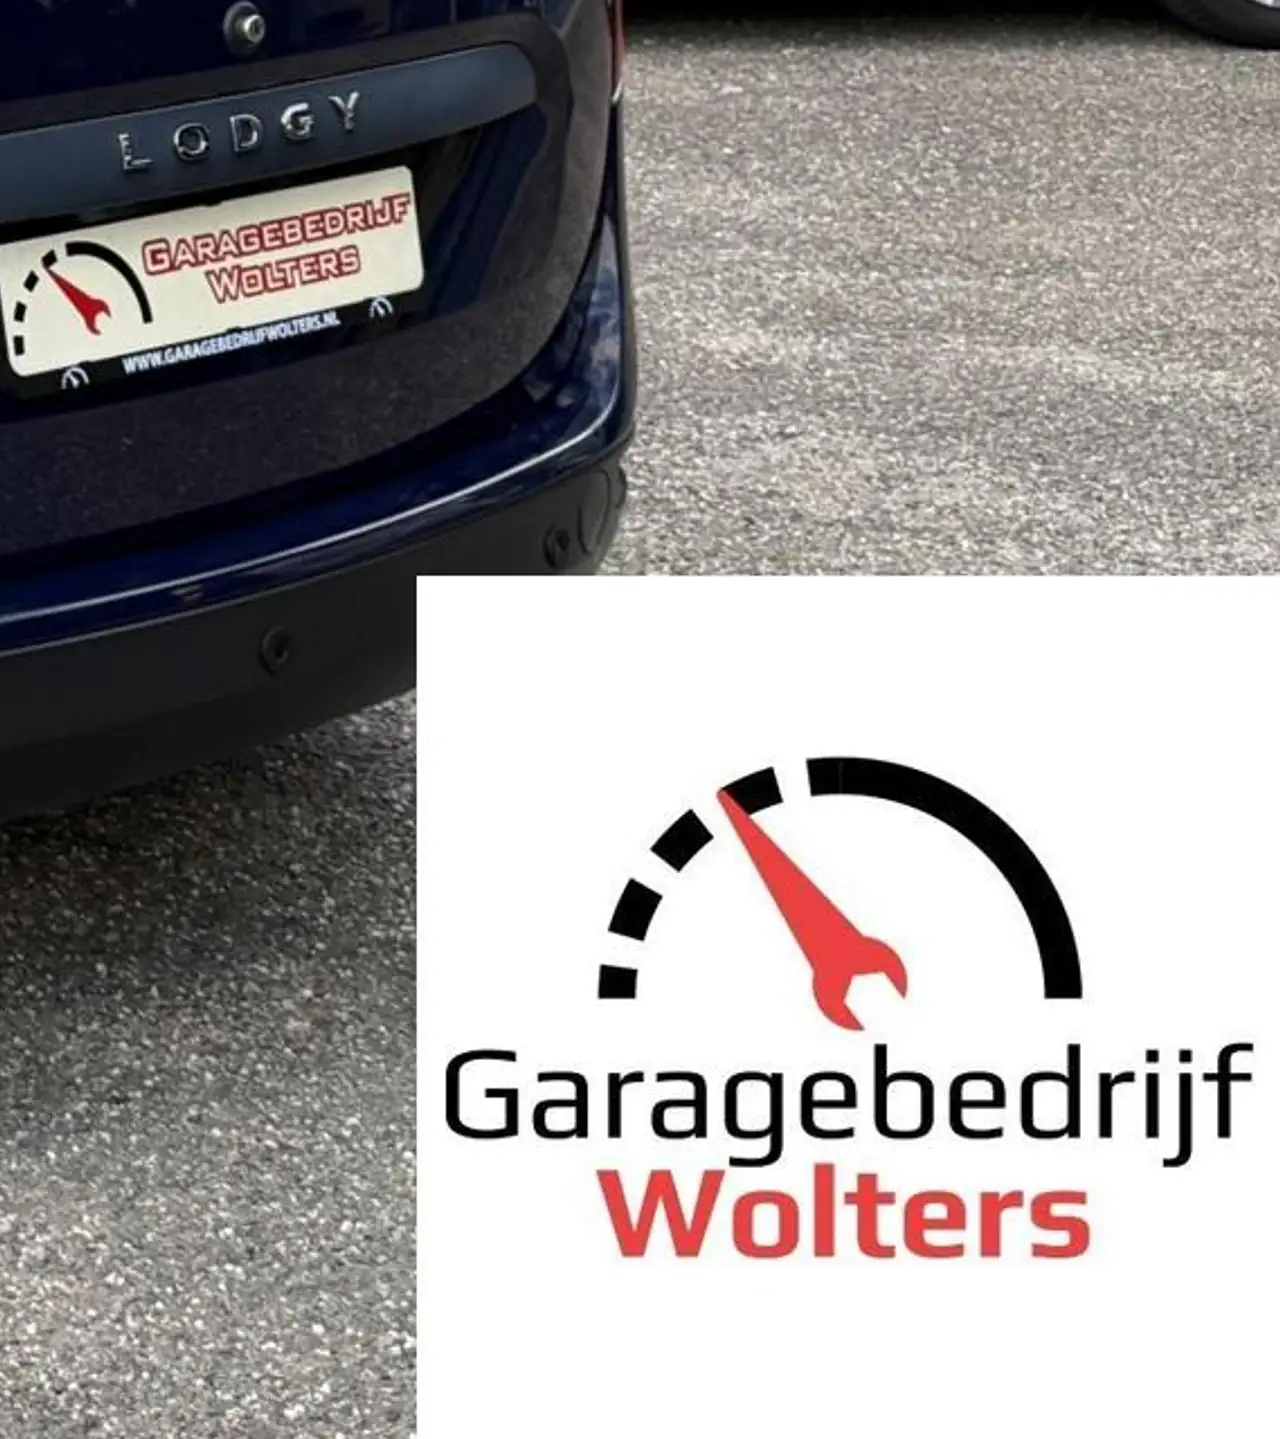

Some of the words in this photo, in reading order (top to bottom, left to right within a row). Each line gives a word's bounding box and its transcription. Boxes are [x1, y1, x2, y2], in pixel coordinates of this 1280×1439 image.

[117, 91, 360, 172] LODGY
[142, 193, 411, 275] GARAGEBEDRIJF
[206, 245, 361, 304] WOLTERS
[121, 311, 341, 375] WWW.GARAGEBEDRIJFWOLTERS.NL
